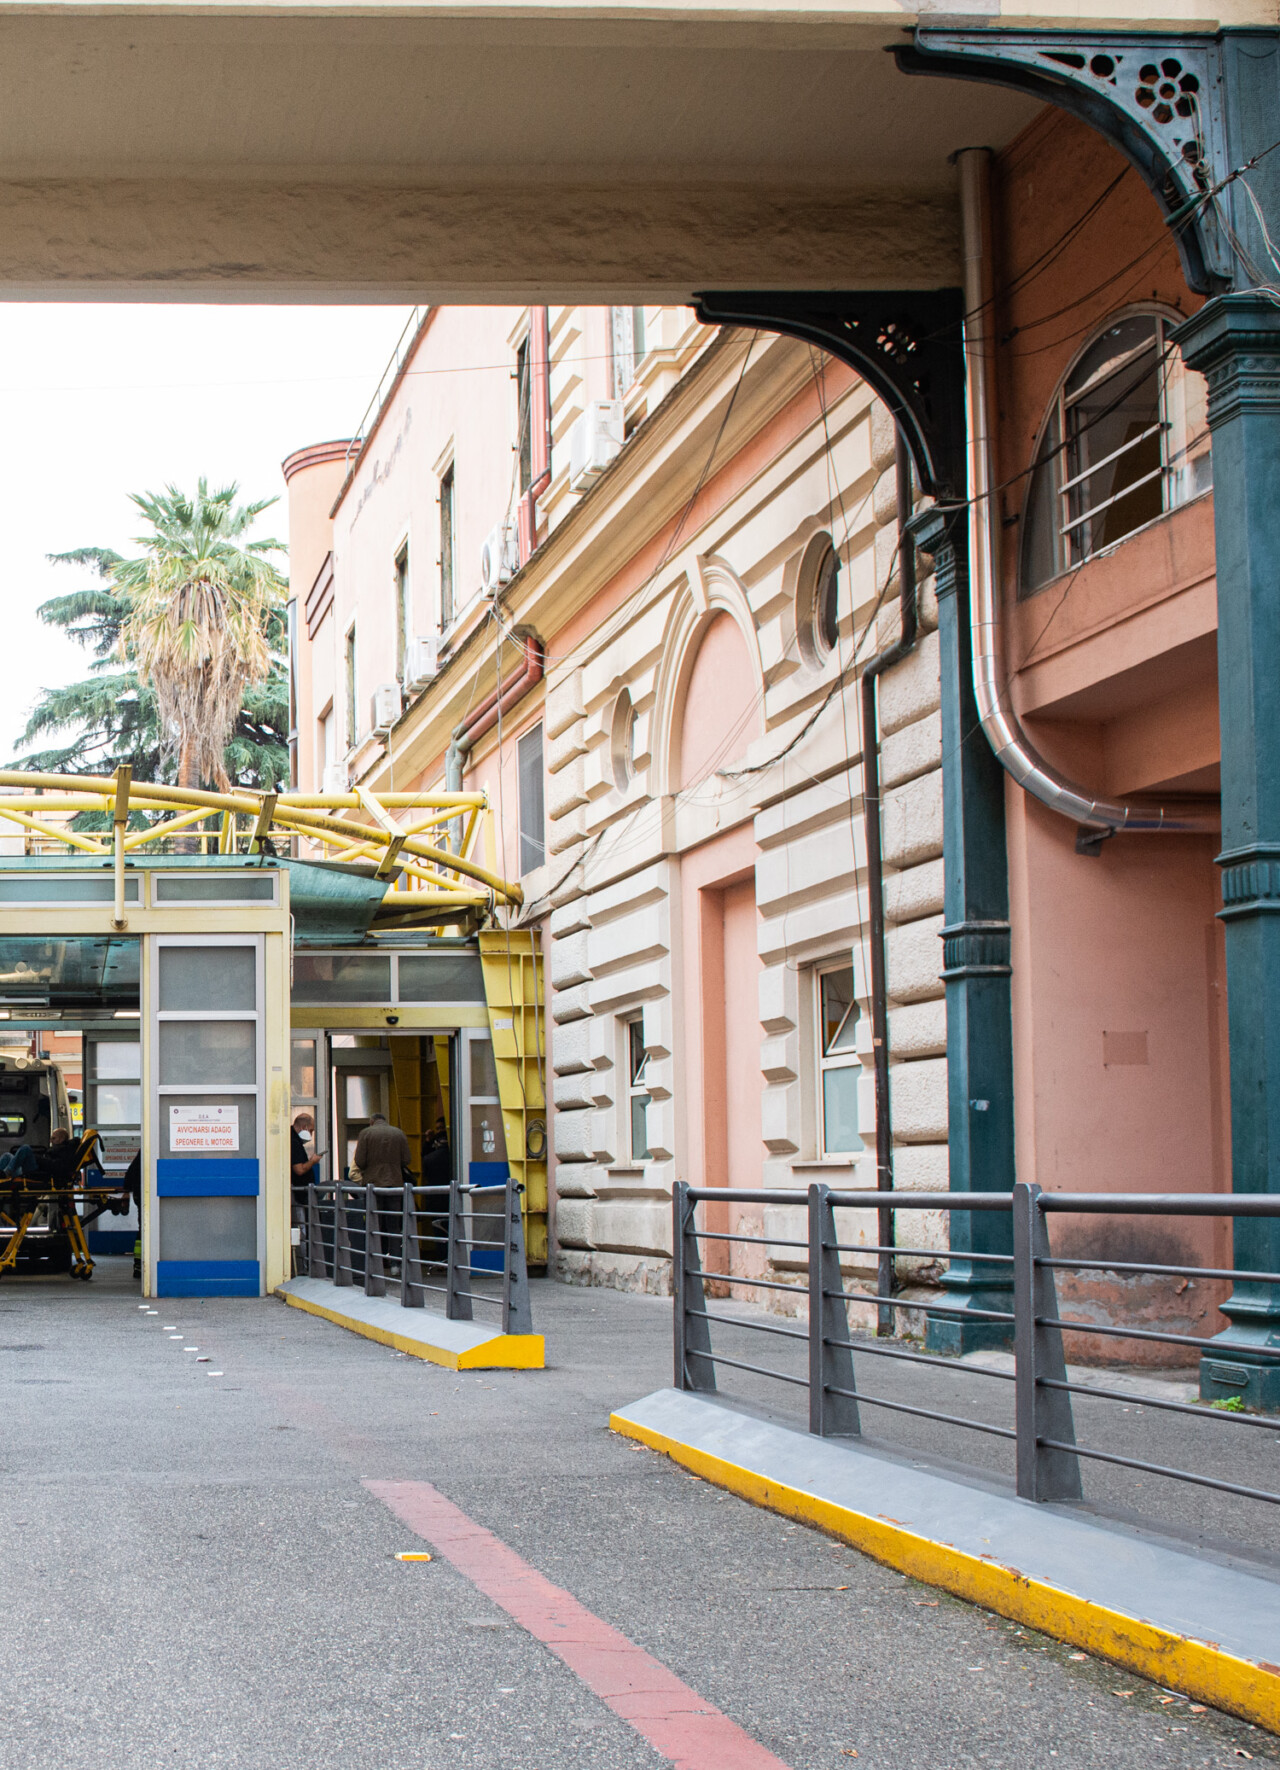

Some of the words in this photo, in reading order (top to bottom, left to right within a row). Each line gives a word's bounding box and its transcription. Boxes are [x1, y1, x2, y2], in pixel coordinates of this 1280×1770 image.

[175, 1138, 204, 1146] SPEGNERE
[205, 1138, 210, 1146] IL
[211, 1138, 233, 1146] MOTORE
